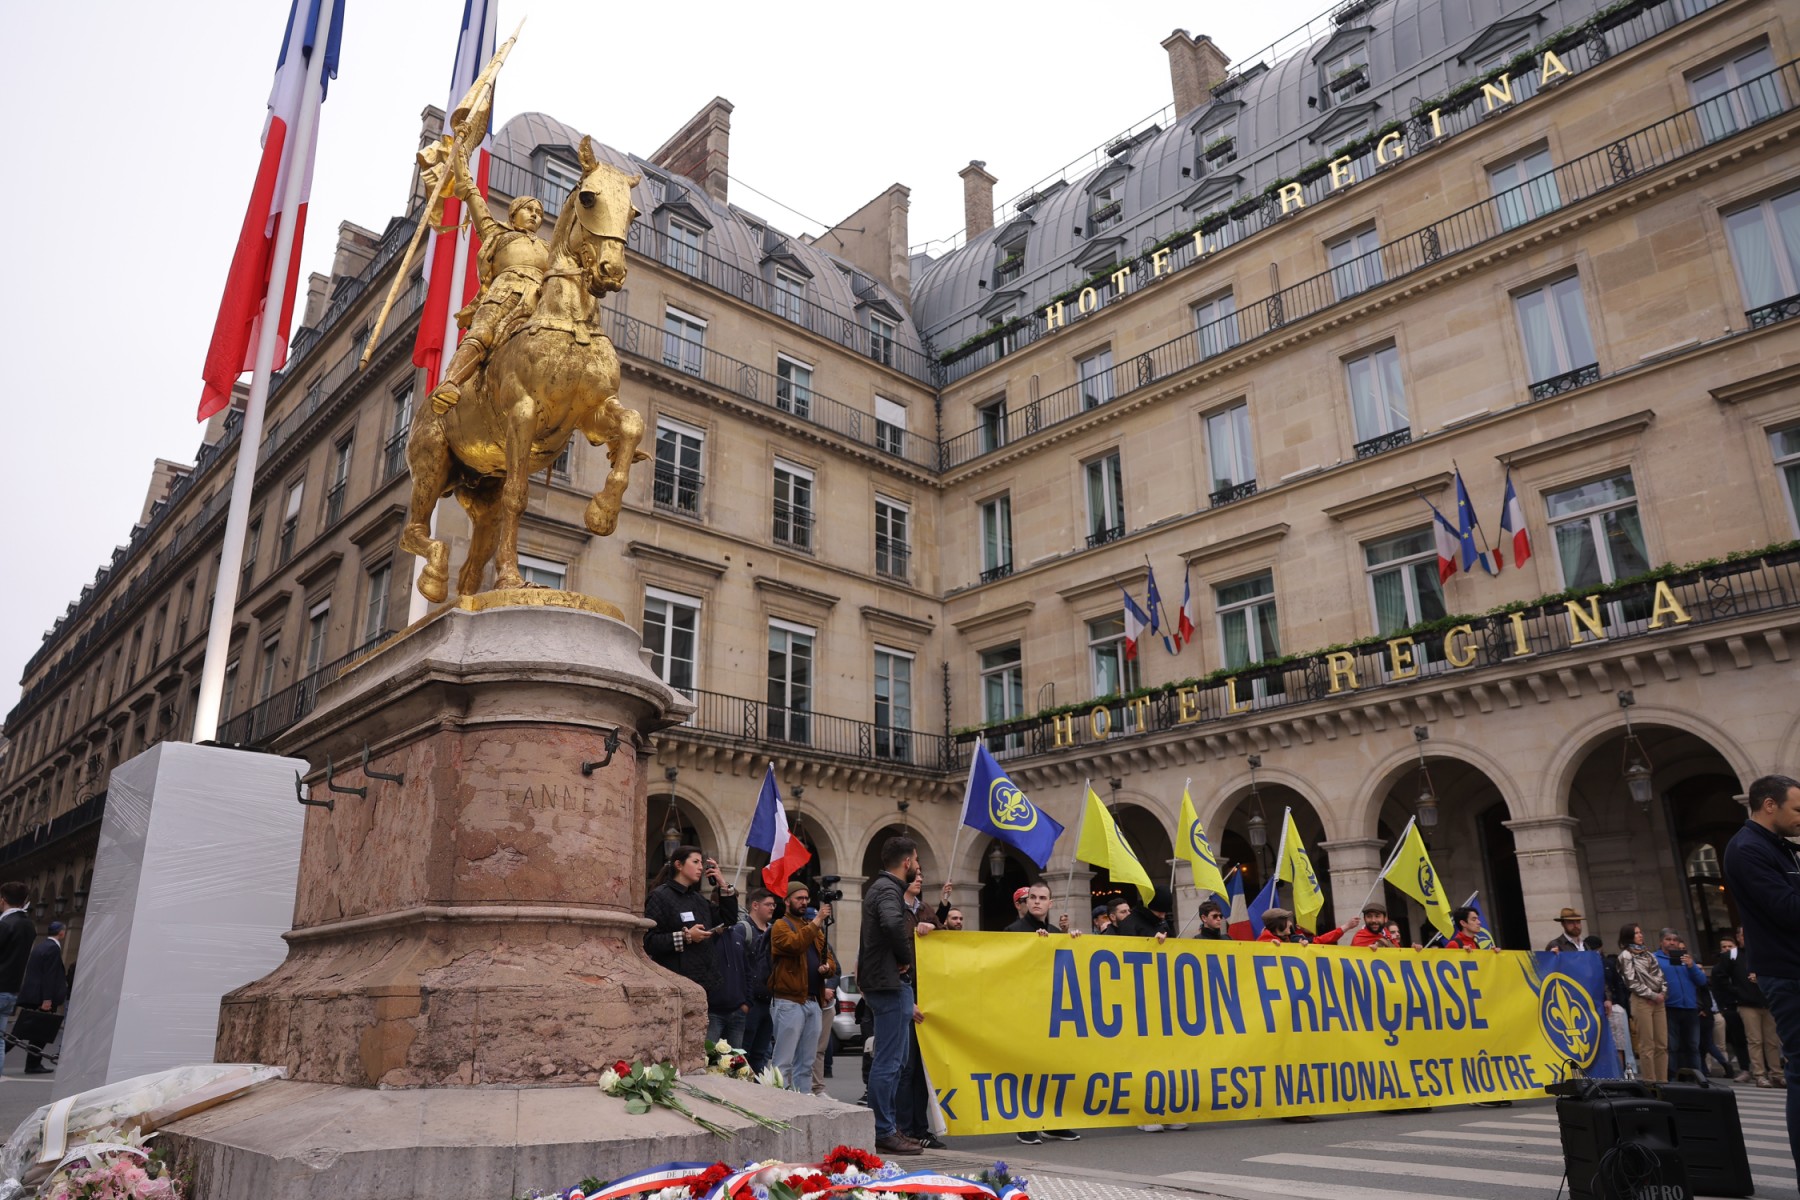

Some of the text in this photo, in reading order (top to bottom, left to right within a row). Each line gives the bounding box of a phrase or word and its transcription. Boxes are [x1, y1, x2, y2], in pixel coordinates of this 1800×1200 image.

[1045, 49, 1573, 331] HOTEL REGINA
[1052, 579, 1693, 748] HOTEL REGINA
[1048, 948, 1489, 1046] ACTION FRANÇAISE
[970, 1072, 1076, 1121] TOUT
[1083, 1071, 1134, 1117] CE
[1144, 1069, 1200, 1116] QUI
[1211, 1065, 1267, 1111] EST
[1275, 1059, 1410, 1105] NATIONAL
[1410, 1057, 1454, 1098] EST
[1461, 1049, 1545, 1094] NÔTRE
